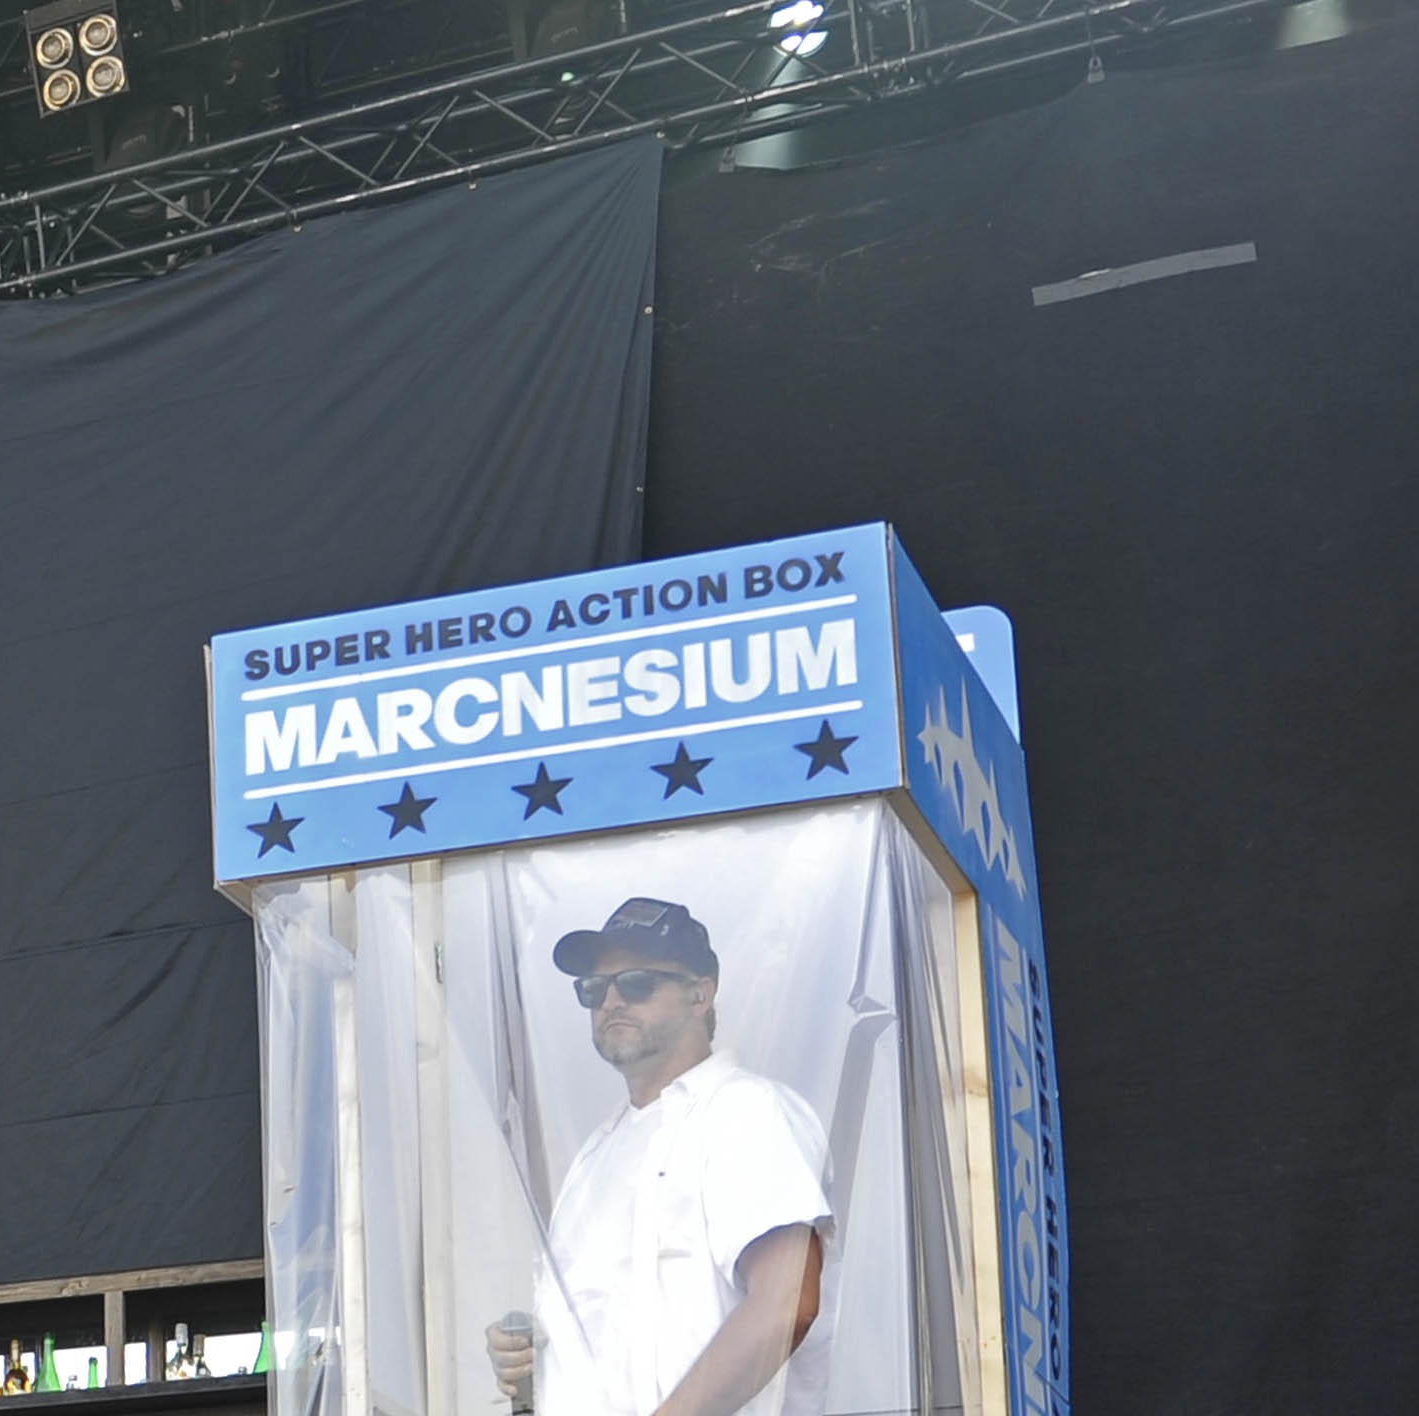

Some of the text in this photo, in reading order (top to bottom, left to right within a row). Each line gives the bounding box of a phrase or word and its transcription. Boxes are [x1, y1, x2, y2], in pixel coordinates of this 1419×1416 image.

[244, 551, 846, 681] SUPER HERO ACTION BOX
[245, 618, 858, 776] MARCNESIUM
[1028, 958, 1055, 1177] SUPER
[1045, 1194, 1062, 1382] HERO
